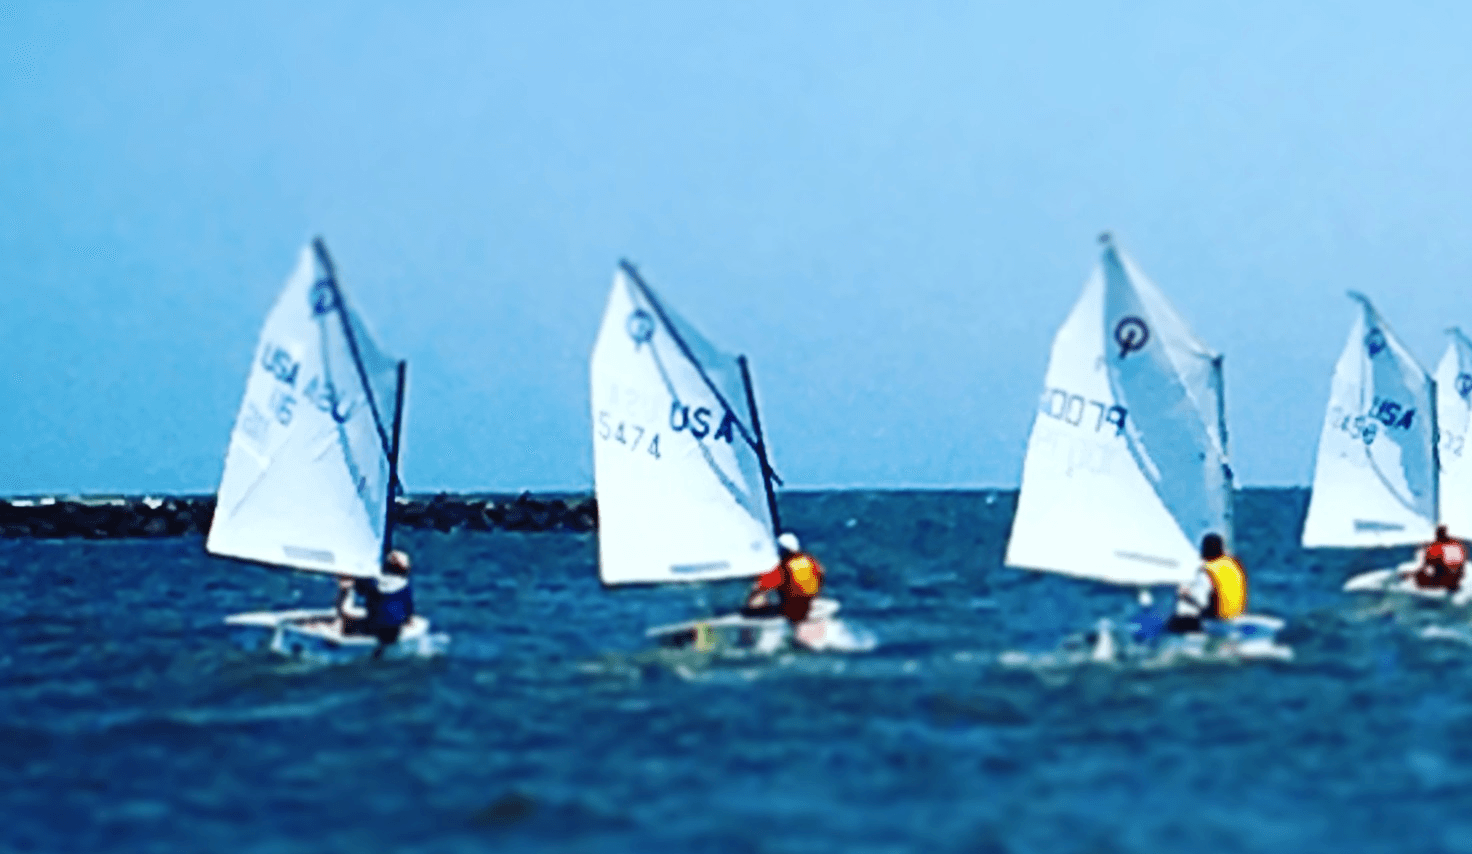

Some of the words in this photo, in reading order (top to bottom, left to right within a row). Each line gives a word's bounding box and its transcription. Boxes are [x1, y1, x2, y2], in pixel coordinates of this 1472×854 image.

[262, 342, 300, 388] USA
[597, 409, 661, 461] 5474
[668, 400, 734, 445] USA
[1368, 394, 1419, 432] USA
